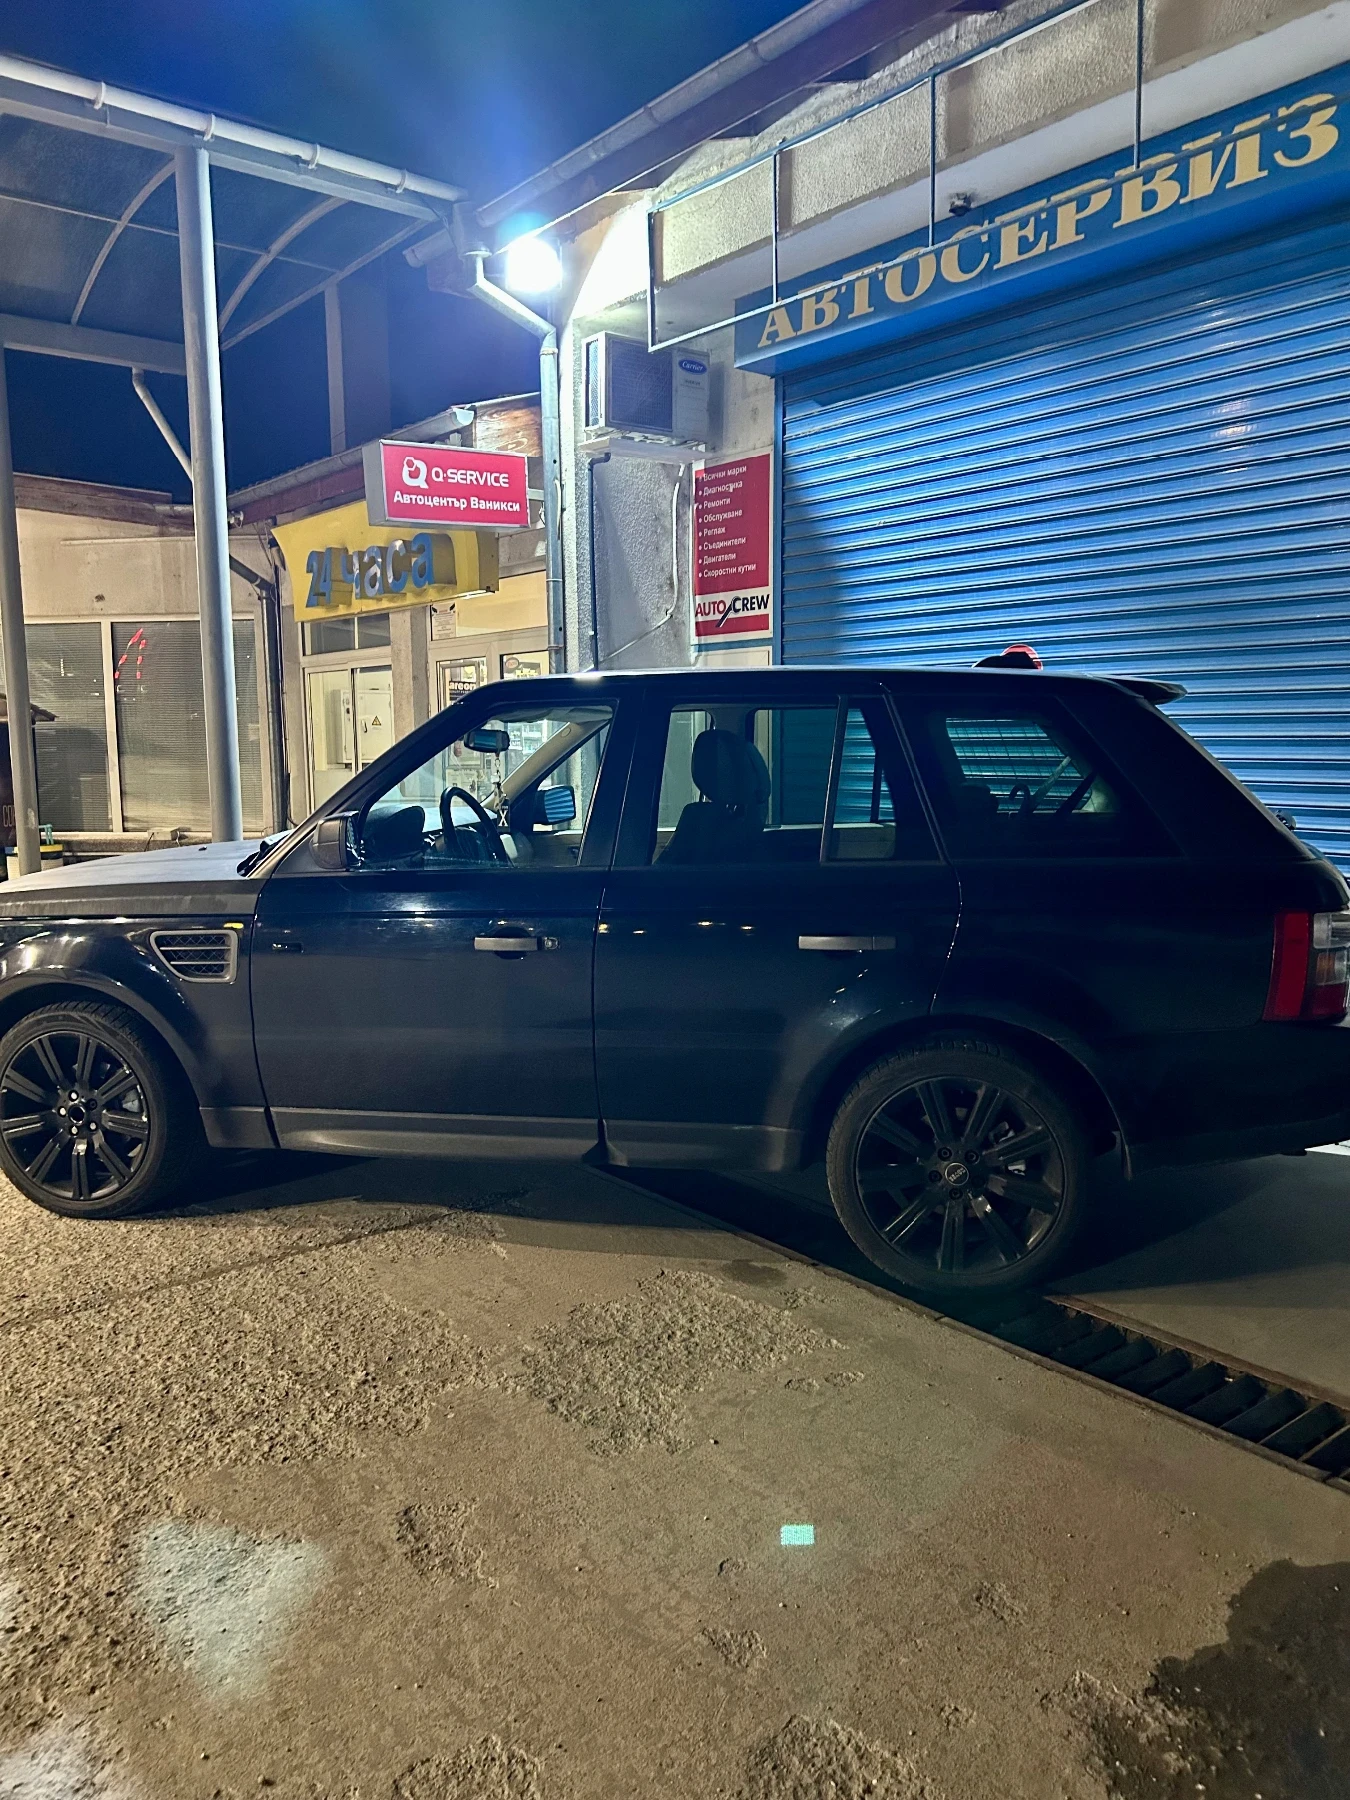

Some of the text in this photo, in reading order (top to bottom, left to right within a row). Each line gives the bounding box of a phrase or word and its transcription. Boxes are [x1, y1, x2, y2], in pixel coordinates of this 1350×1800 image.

[757, 92, 1339, 348] АВТОСЕРВИЗ
[682, 361, 703, 371] Carrier
[703, 465, 747, 481] Всички марки
[703, 480, 743, 497] Диагностика
[393, 490, 520, 512] Автоцентър Ваникси
[703, 497, 731, 509] Ремонти
[703, 509, 743, 523] Обслужване
[703, 536, 747, 551] Съединители
[703, 552, 737, 566] Двигатели
[306, 532, 435, 608] 24 часа
[703, 563, 757, 578] Скоростни кутии
[695, 594, 770, 617] AUTO CREW
[449, 682, 476, 691] areon
